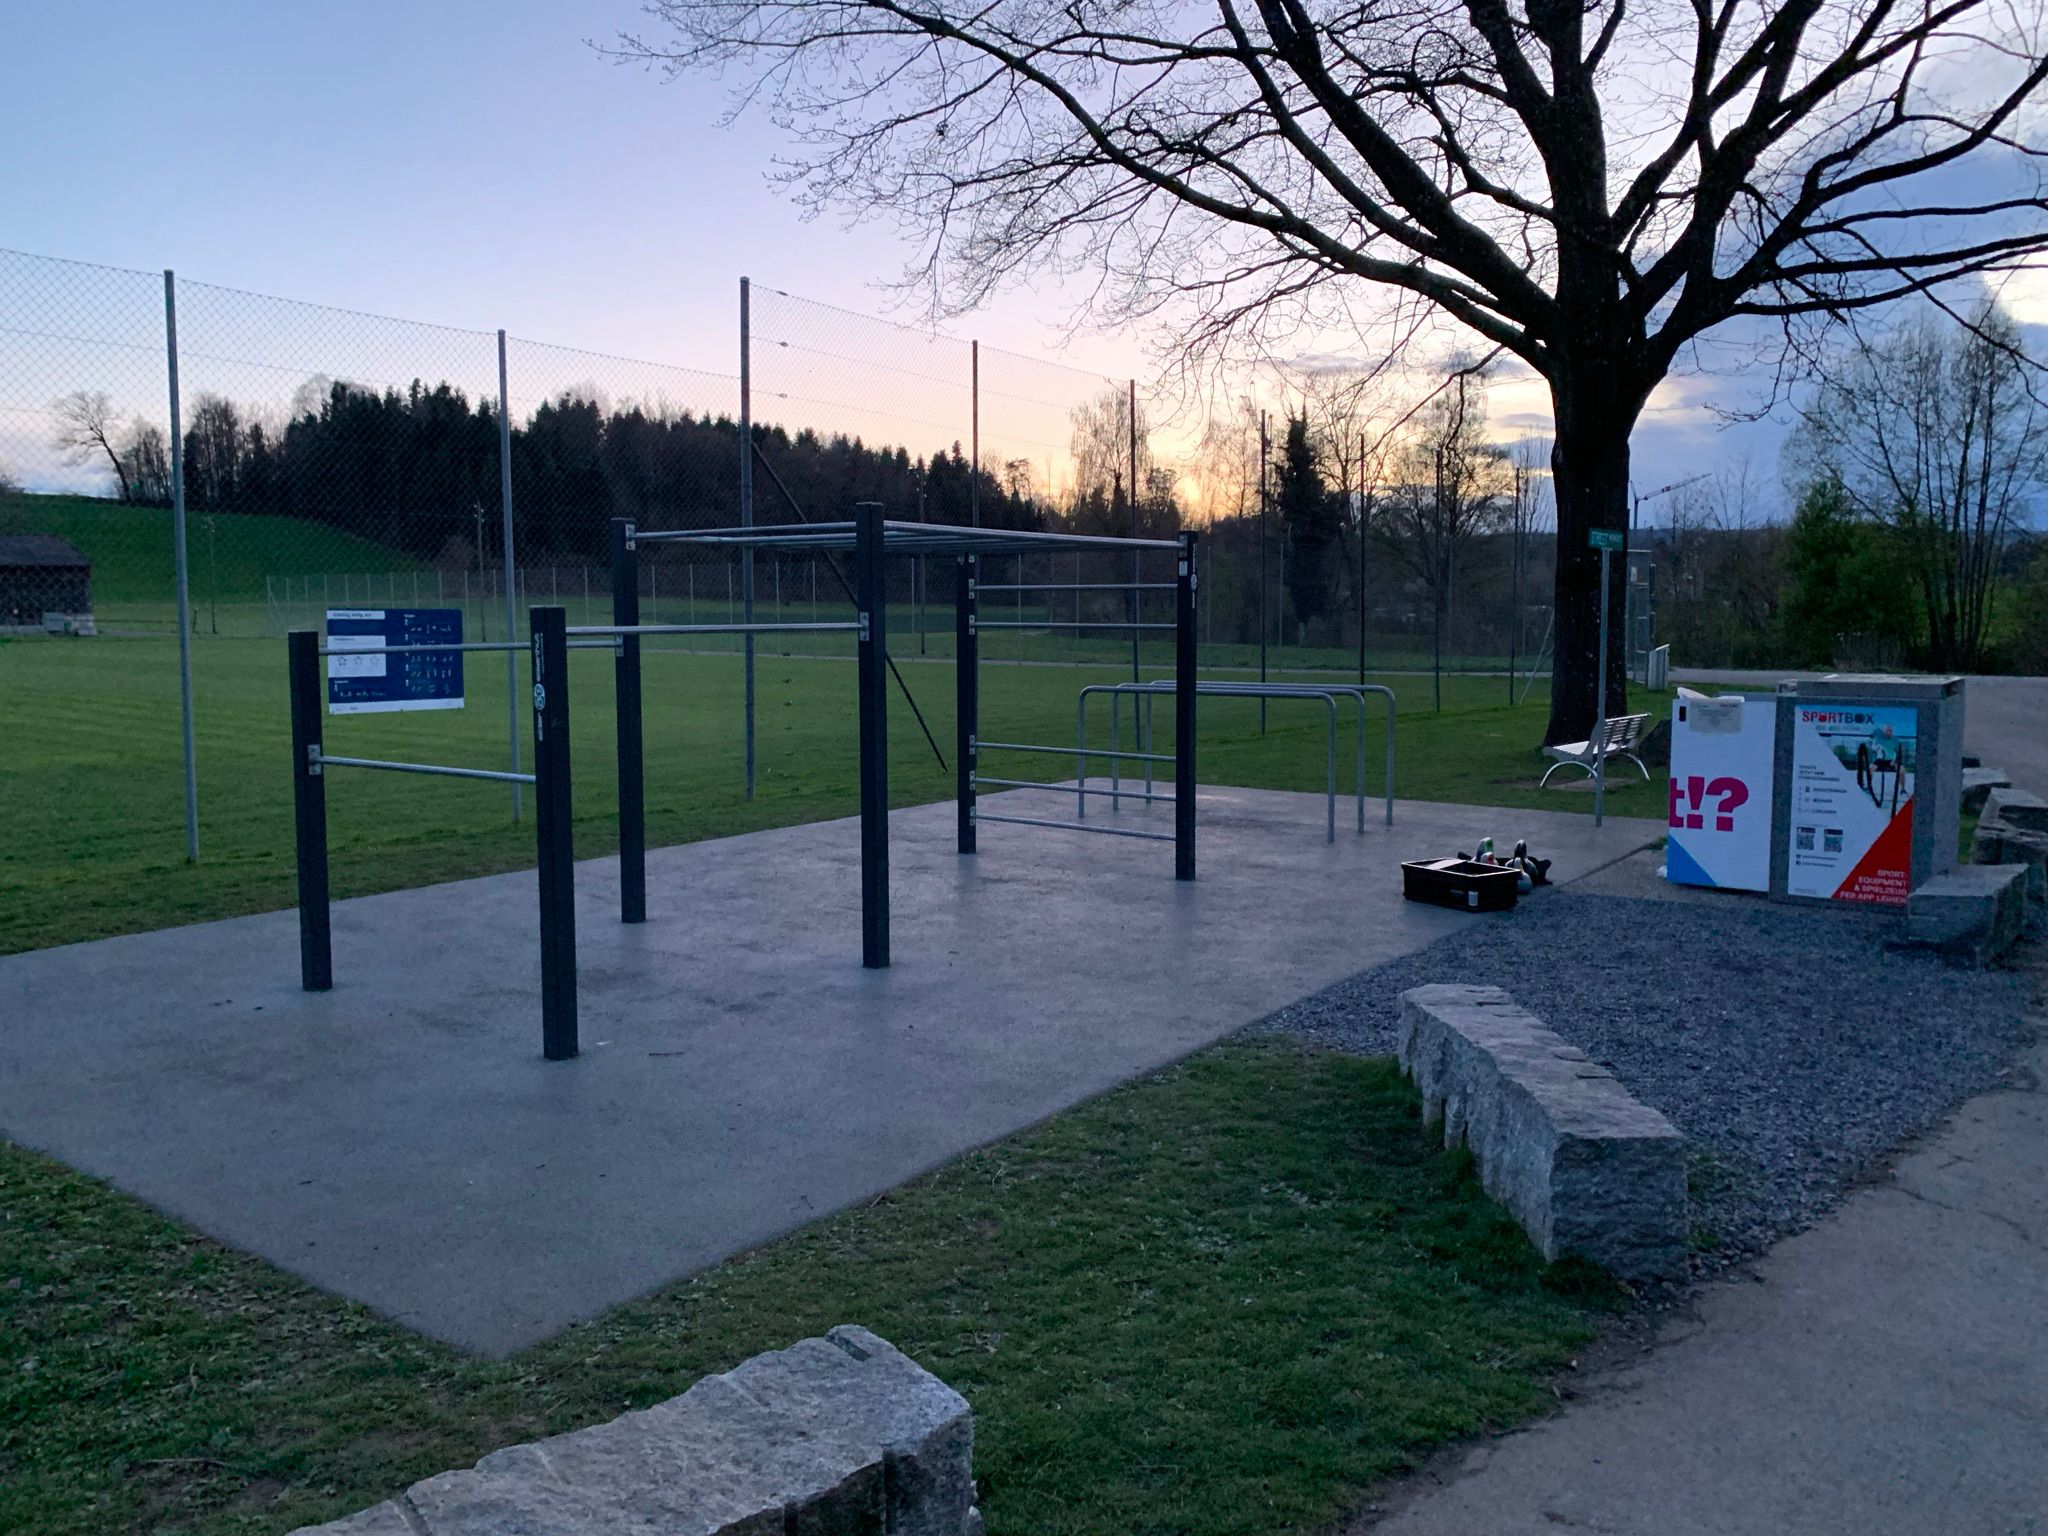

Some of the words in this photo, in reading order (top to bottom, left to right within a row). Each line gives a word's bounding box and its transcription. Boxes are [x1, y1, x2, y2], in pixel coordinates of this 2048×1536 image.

[1802, 711, 1875, 724] SPORTBOX
[1858, 876, 1907, 886] EQUIPMENT
[1840, 891, 1856, 899] PER
